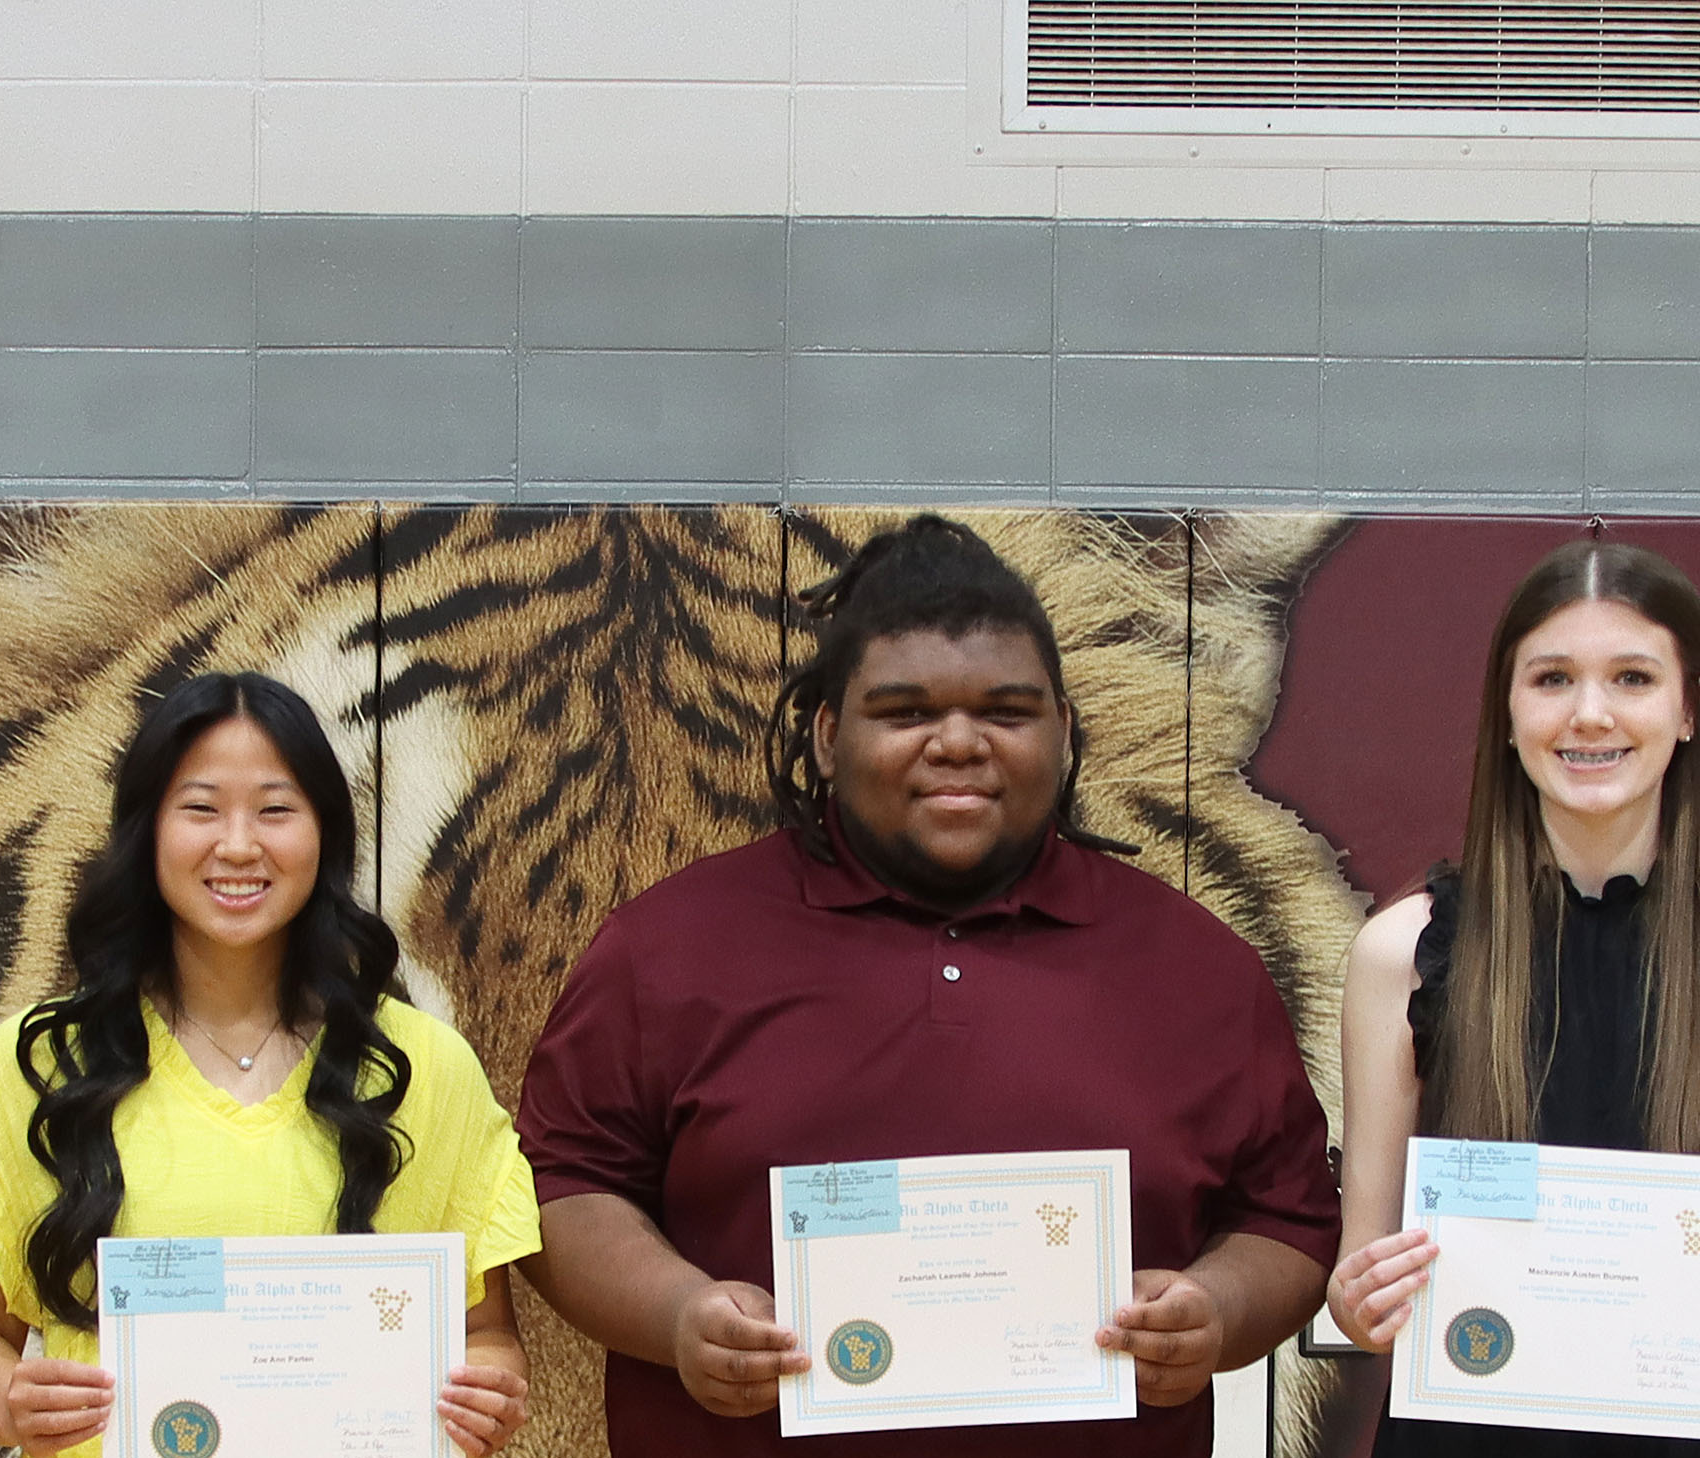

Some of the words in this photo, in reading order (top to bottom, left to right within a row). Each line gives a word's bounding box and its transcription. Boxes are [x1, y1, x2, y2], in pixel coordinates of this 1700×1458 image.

[924, 1202, 963, 1217] Alpha
[969, 1200, 1009, 1213] Theta
[1561, 1193, 1601, 1211] Alpha
[1608, 1197, 1648, 1213] Theta
[898, 1274, 937, 1283] Zachariah
[973, 1271, 1008, 1279] Johnson
[1528, 1267, 1571, 1277] Mackenzie
[1603, 1272, 1639, 1282] Bumpers
[225, 1283, 249, 1296] Mu
[255, 1281, 295, 1298] Alpha
[301, 1281, 342, 1297] Theta
[252, 1356, 268, 1364] Zoe
[269, 1355, 286, 1364] Ann
